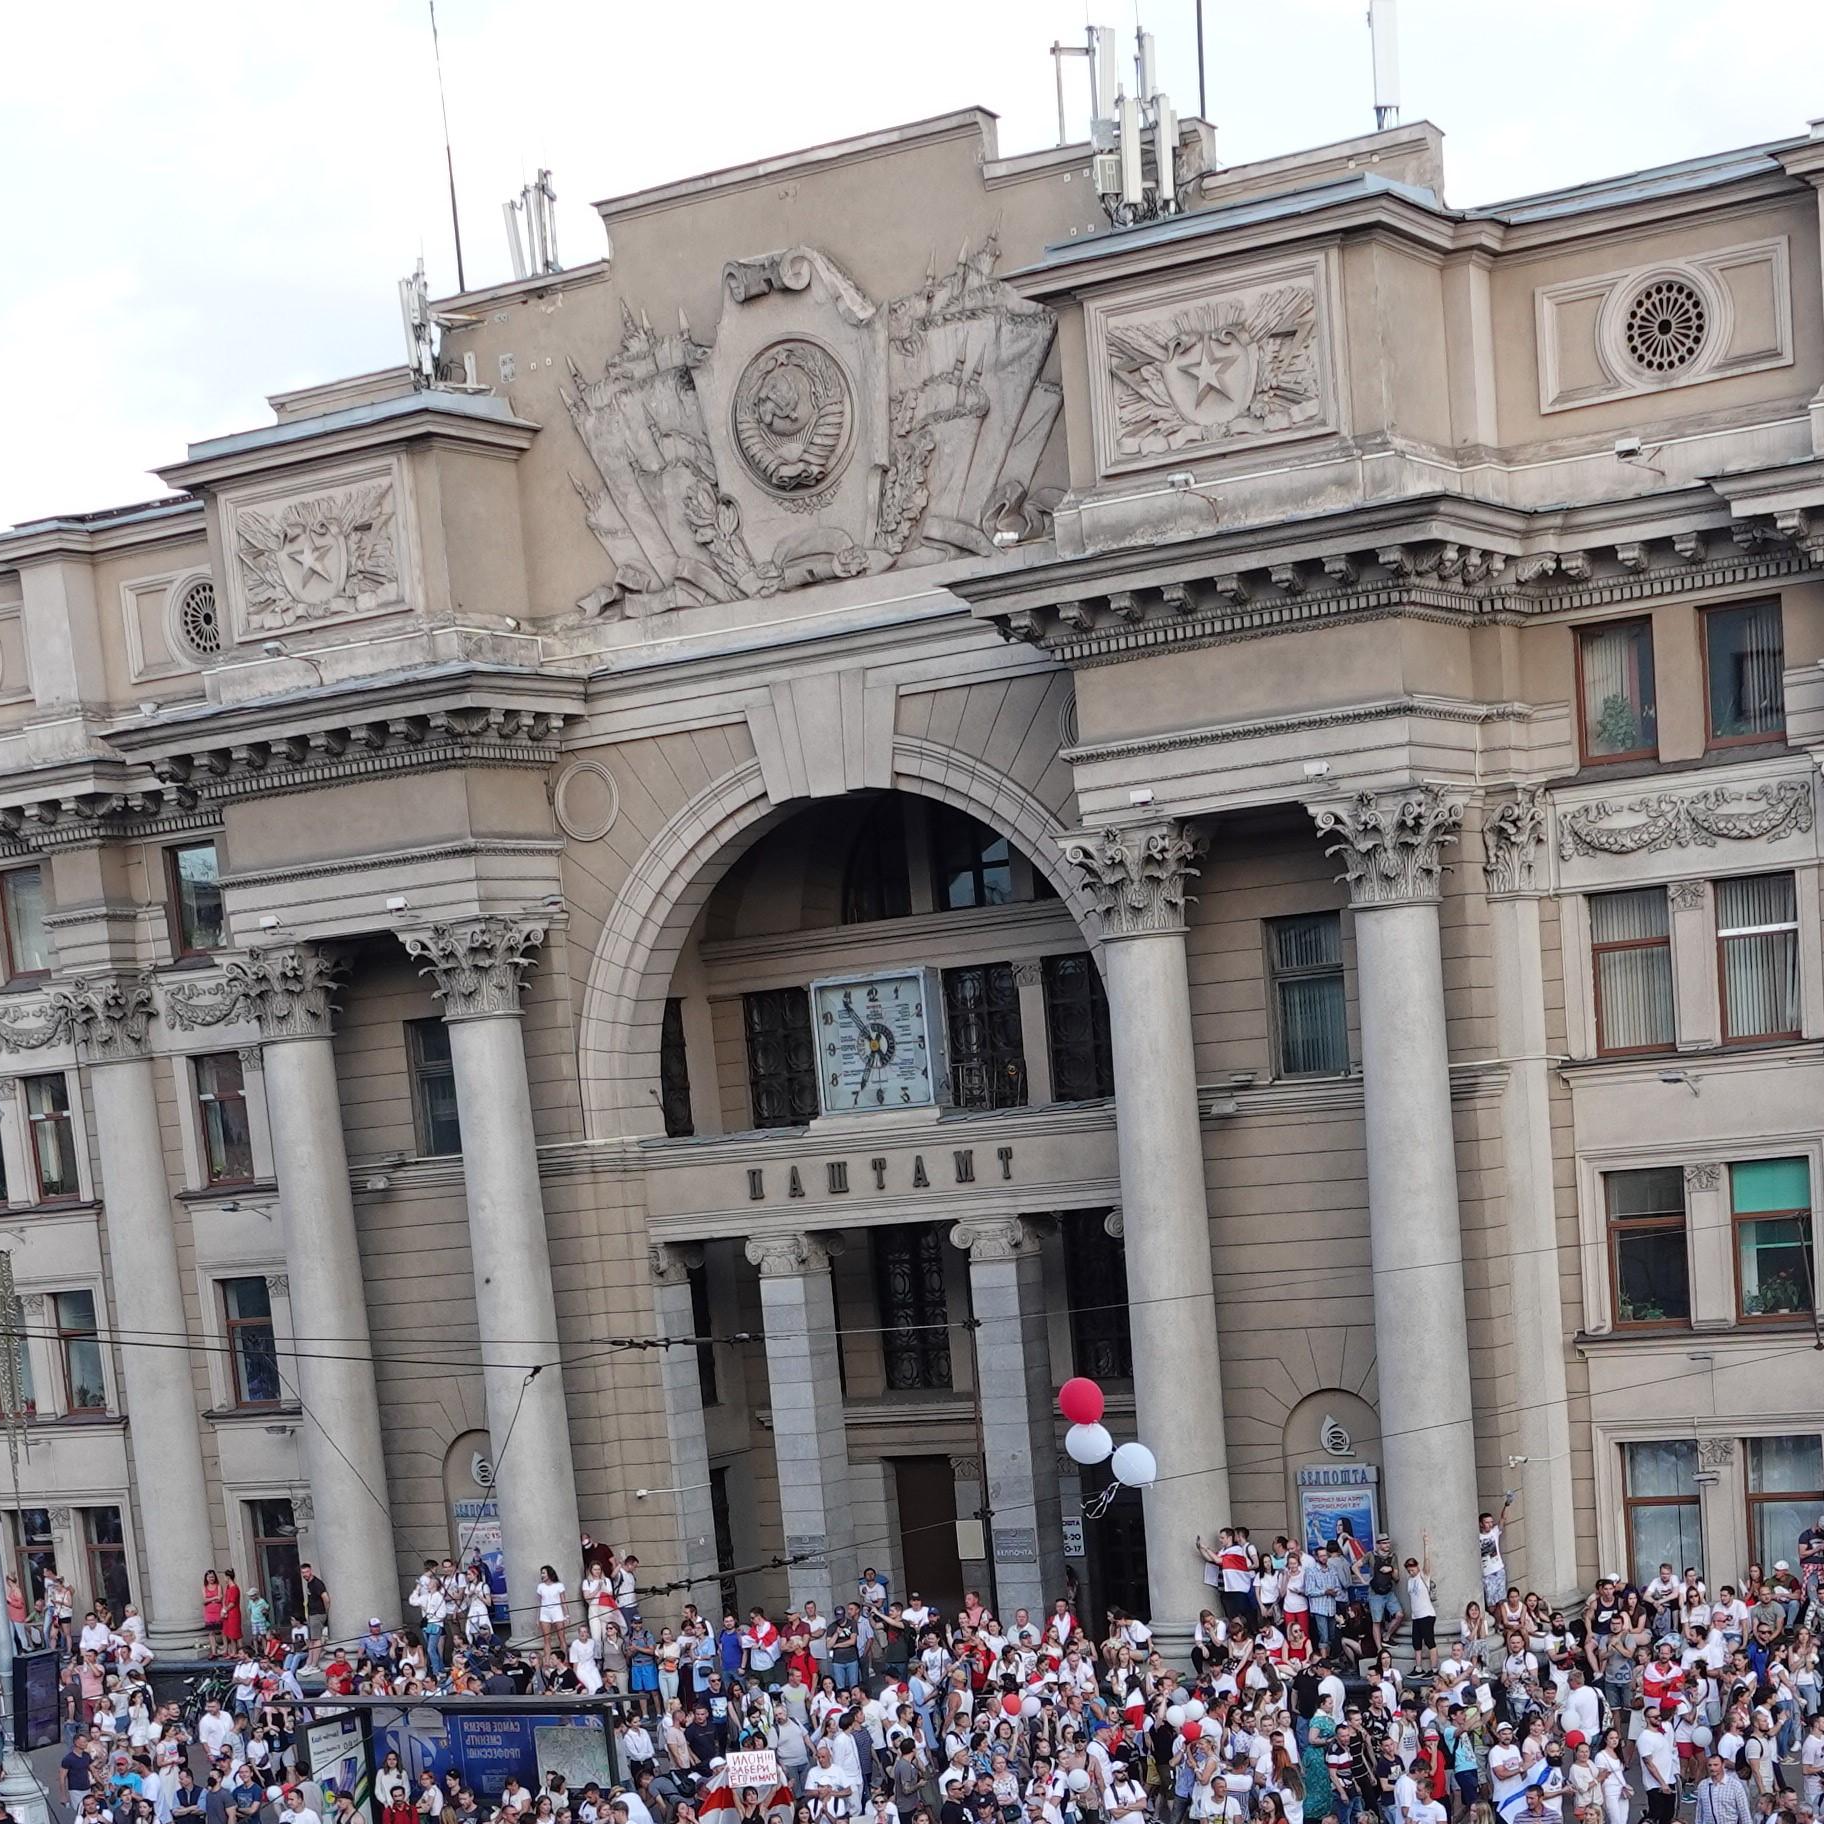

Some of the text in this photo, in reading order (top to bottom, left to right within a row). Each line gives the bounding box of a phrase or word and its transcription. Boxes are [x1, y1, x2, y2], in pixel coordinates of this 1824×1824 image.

[746, 1146, 1013, 1200] ПАШТАМТ
[1300, 1468, 1369, 1486] БЕЛПОШТА
[732, 1753, 774, 1766] ИЛОН!!!
